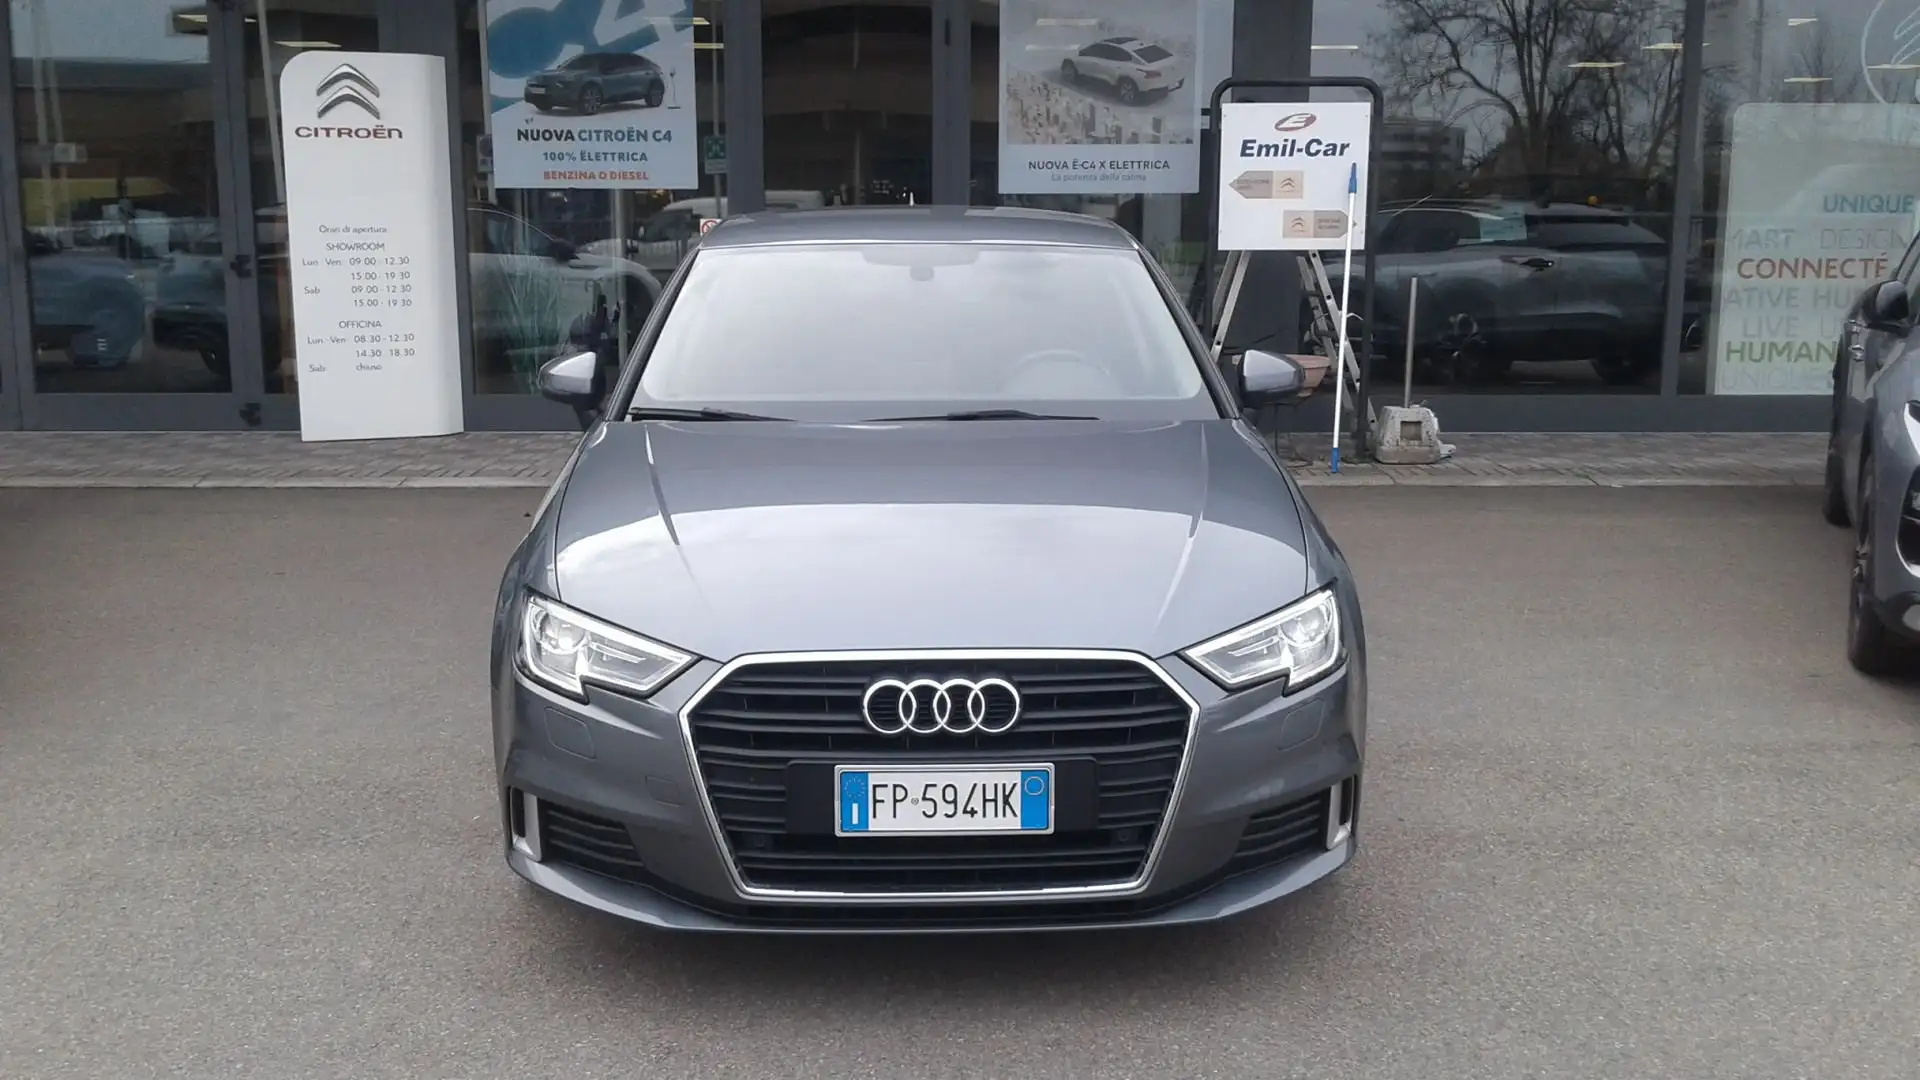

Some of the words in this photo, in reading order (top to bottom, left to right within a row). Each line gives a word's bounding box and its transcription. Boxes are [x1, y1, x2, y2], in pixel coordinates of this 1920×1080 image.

[517, 129, 575, 142] NUOVA
[577, 127, 648, 142] CITROËN
[652, 130, 672, 142] C4
[1239, 138, 1350, 157] Emil-Car
[543, 152, 576, 162] 100%
[1028, 160, 1069, 170] NUOVA
[1099, 160, 1107, 170] X
[1109, 160, 1170, 170] ELETTRICA
[544, 171, 595, 181] BENZINA
[599, 171, 608, 181] O
[610, 171, 649, 181] DIESEL
[1822, 194, 1914, 213] UNIQUE
[352, 225, 387, 235] apertura
[326, 242, 385, 251] SHOWROOM
[338, 320, 383, 329] OFFICINA
[1726, 341, 1837, 363] HUMAN
[872, 784, 909, 819] FP
[921, 783, 1018, 818] 594HK
